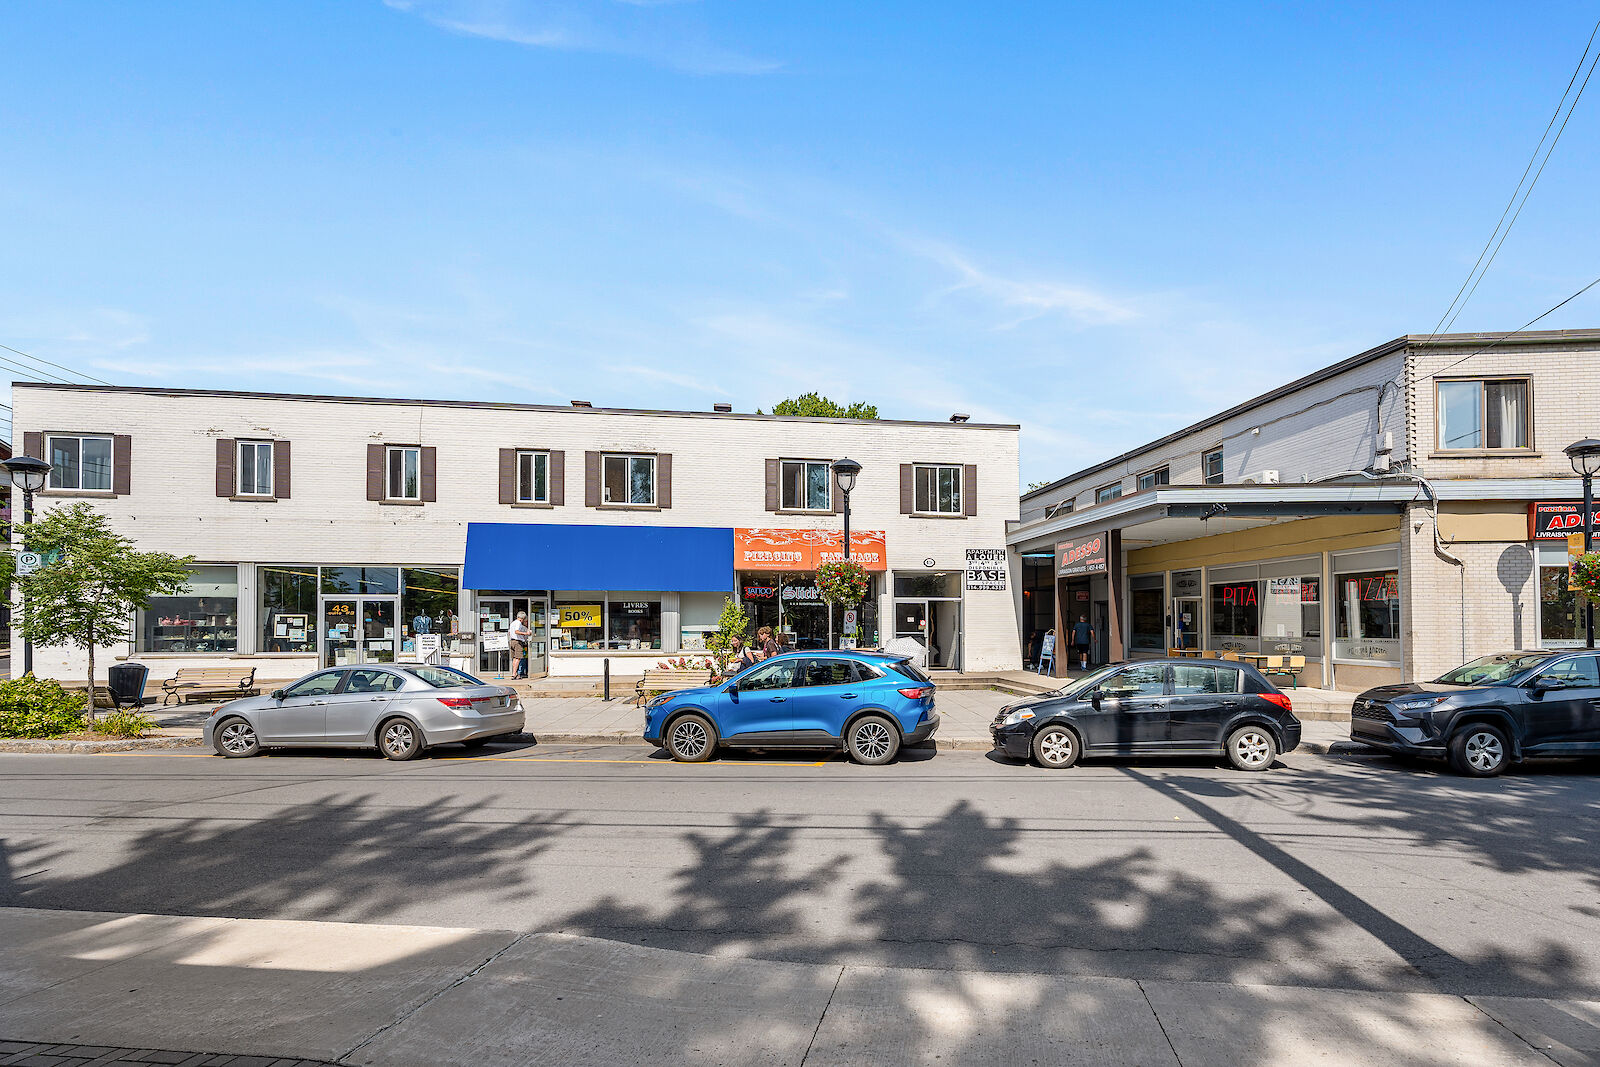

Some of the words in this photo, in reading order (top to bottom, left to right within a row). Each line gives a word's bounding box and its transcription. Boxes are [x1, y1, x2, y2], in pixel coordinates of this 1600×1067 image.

[744, 551, 802, 562] PIERCING
[820, 551, 880, 563] TATUAGE
[1061, 538, 1101, 567] ADESSO
[966, 570, 1006, 581] BASE
[747, 587, 772, 595] TATTOO
[1347, 576, 1399, 601] PIZZA
[1223, 586, 1257, 606] PITA
[332, 604, 350, 613] 43
[564, 610, 593, 622] 50%
